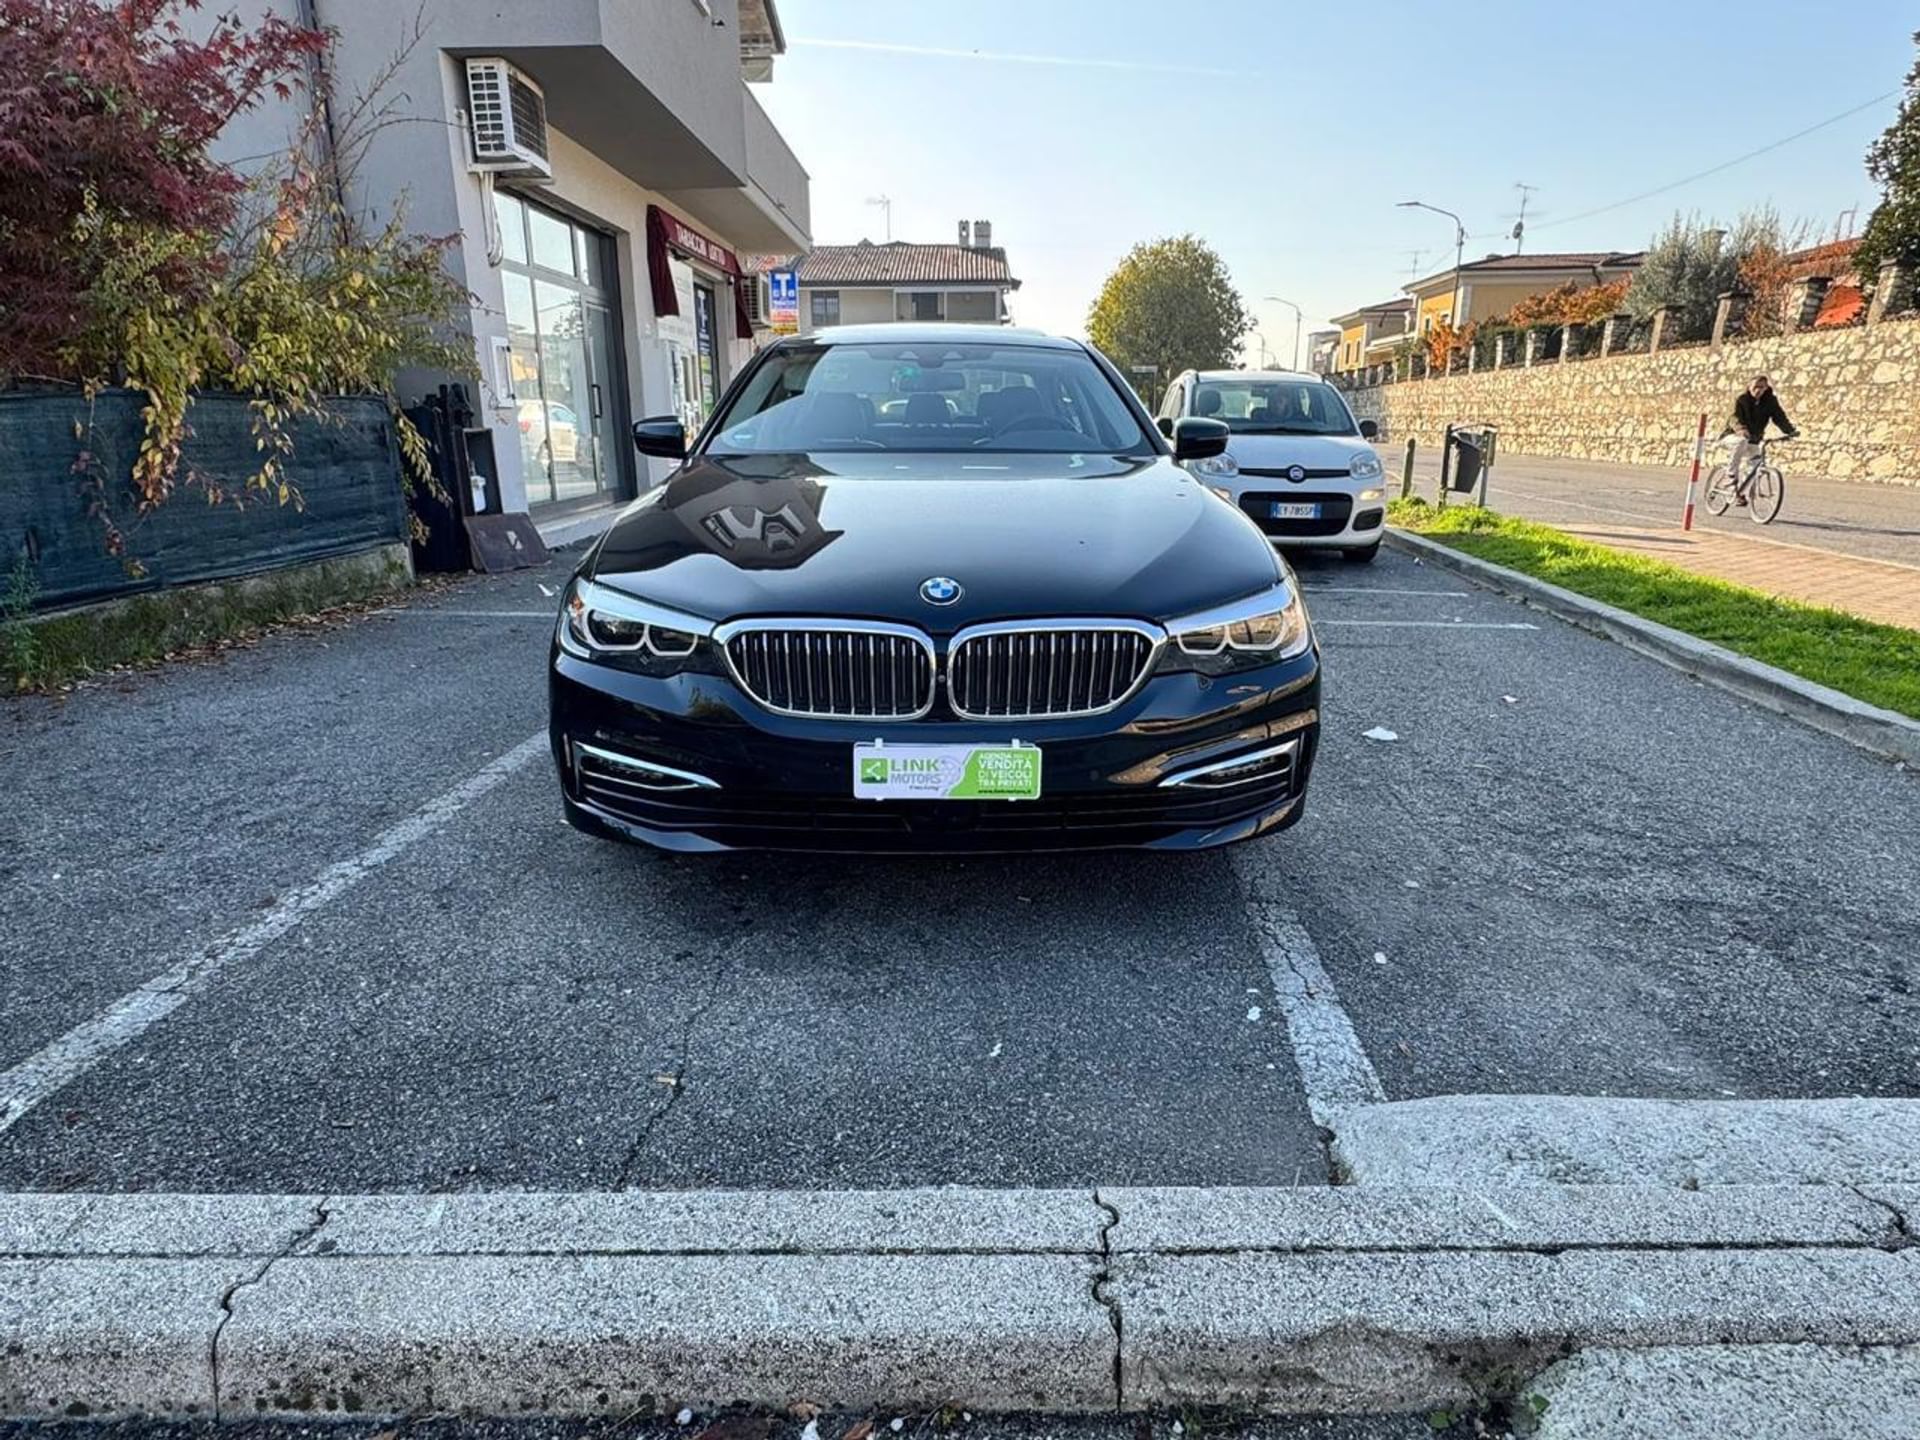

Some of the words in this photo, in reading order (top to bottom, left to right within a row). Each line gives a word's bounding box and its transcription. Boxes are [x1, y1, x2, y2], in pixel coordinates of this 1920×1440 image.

[891, 759, 939, 772] LINK
[978, 759, 1032, 769] VENDITA
[891, 773, 941, 784] MOTORS
[978, 770, 988, 778] DI
[991, 770, 1032, 779] VEICOLI
